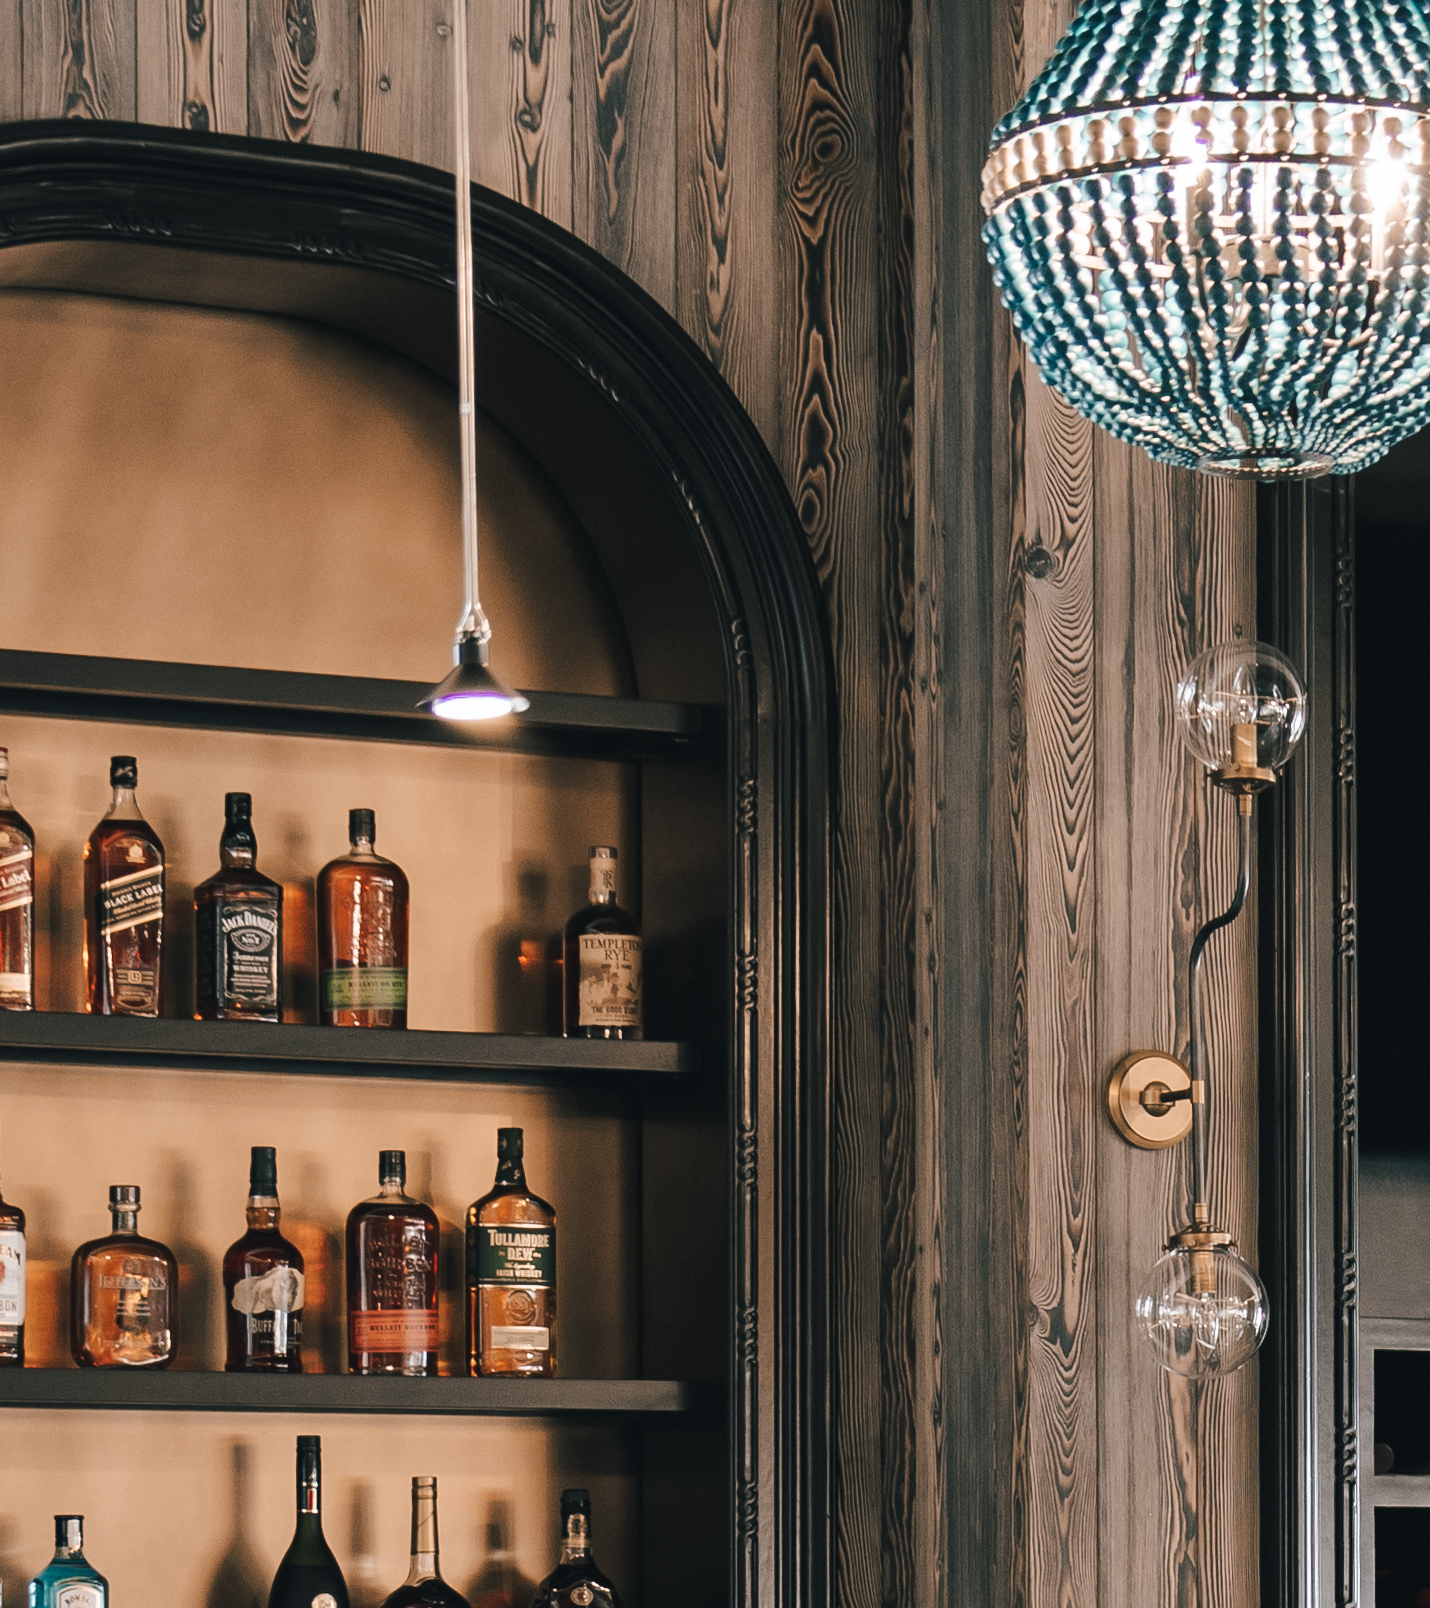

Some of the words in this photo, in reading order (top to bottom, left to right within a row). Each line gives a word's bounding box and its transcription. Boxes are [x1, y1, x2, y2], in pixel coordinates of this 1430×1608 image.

[1, 868, 32, 889] Label
[104, 893, 136, 910] BLACK
[135, 883, 163, 900] LABEL
[221, 915, 246, 933] JACK
[604, 950, 630, 961] RYE
[487, 1229, 549, 1247] TULLAMORE
[252, 1318, 286, 1334] BUFF
